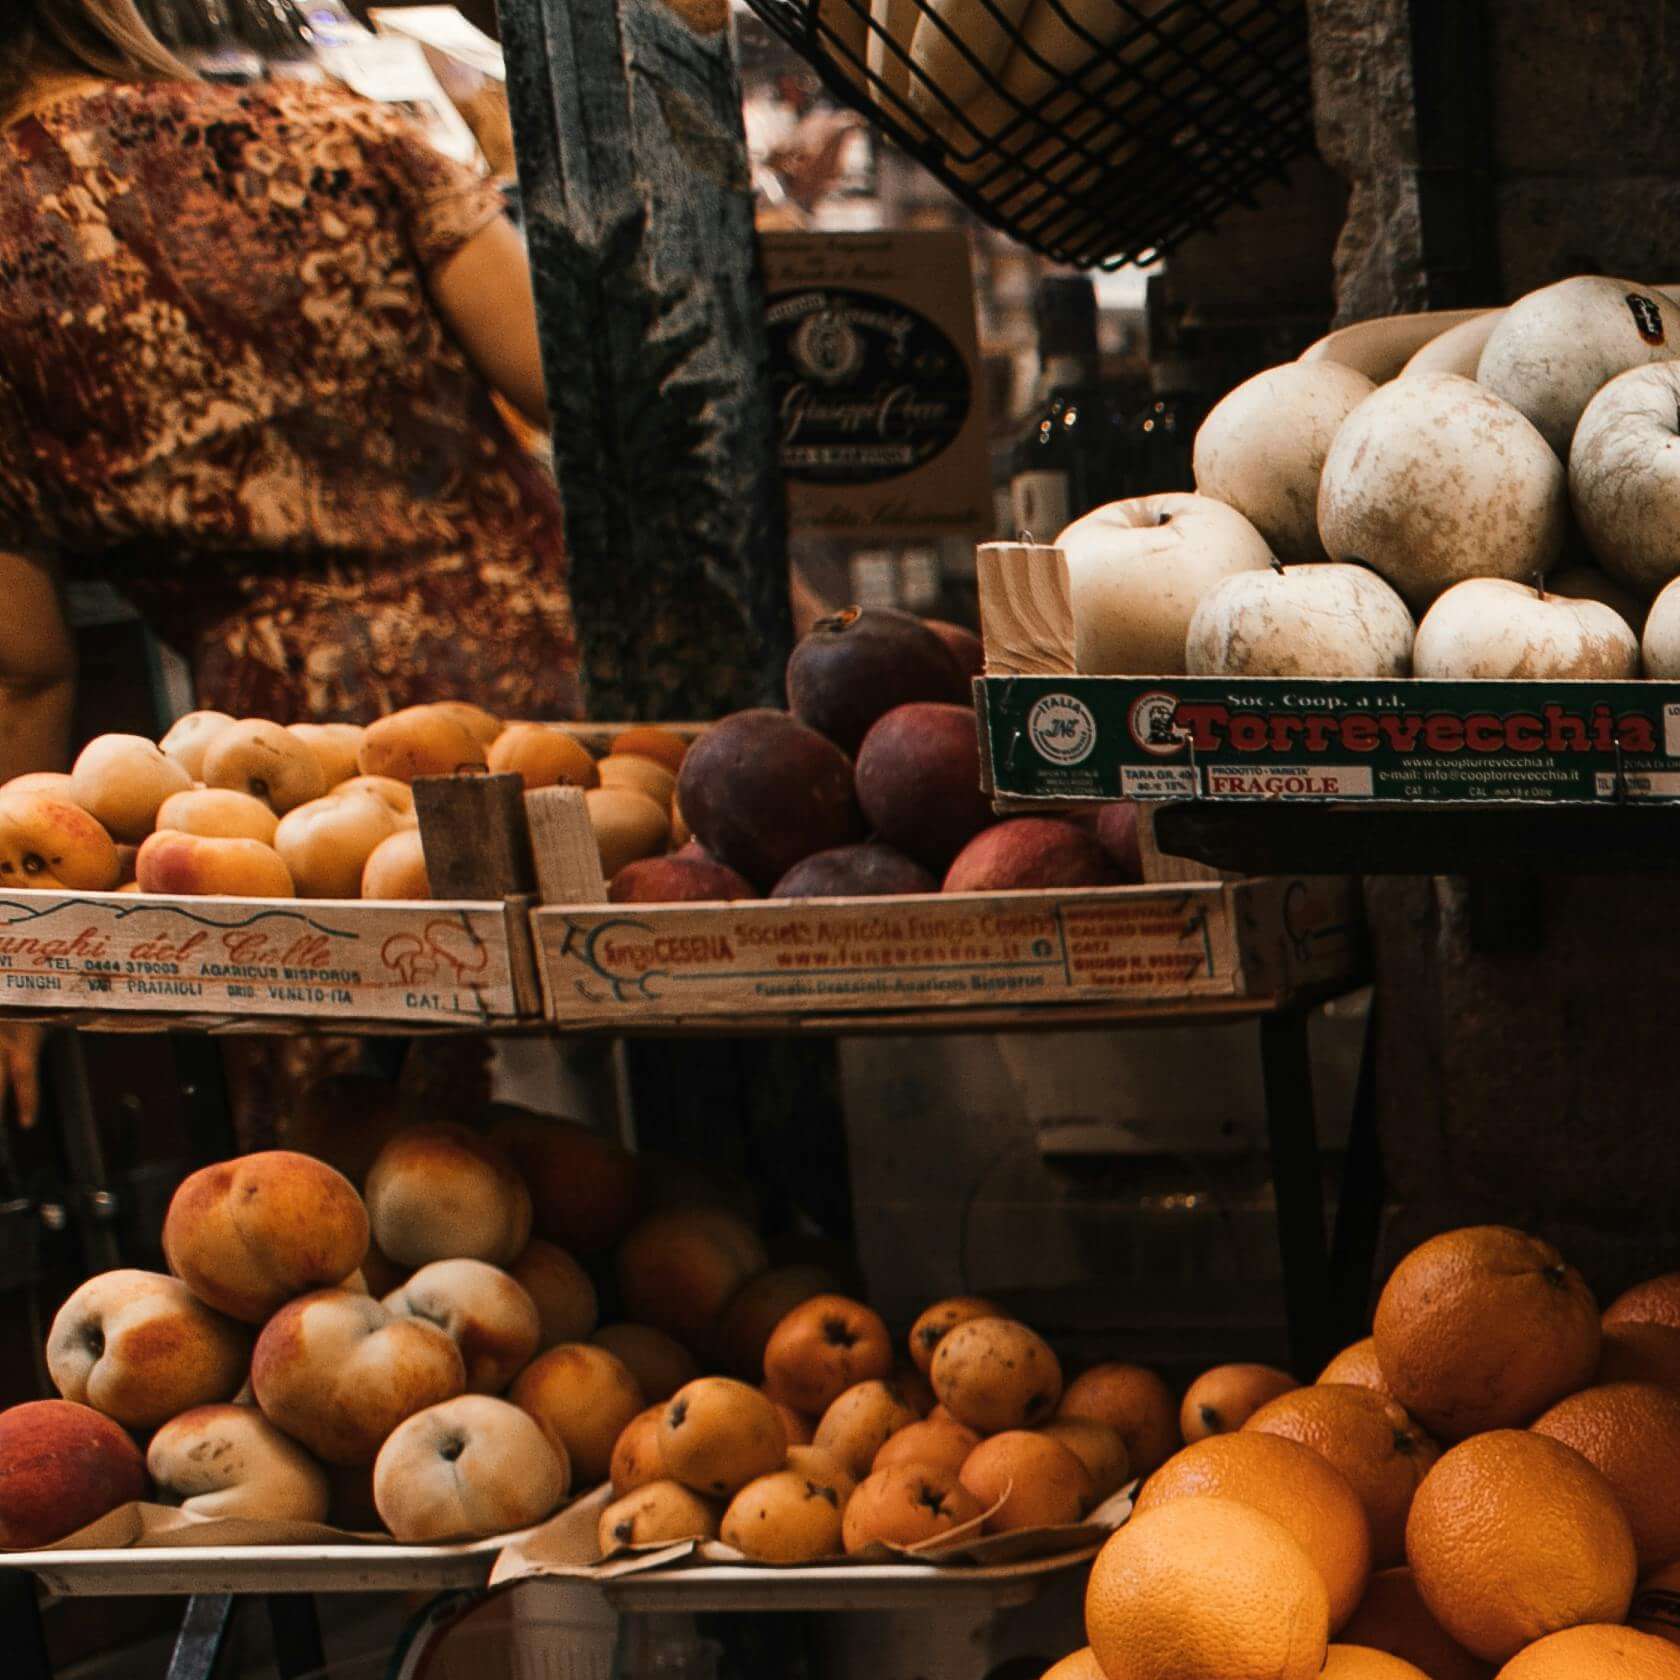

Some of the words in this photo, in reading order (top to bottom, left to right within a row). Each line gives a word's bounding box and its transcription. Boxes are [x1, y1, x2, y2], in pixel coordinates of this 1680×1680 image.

[1282, 694, 1349, 712] Coop.
[1173, 701, 1658, 754] Torrevecchia
[1213, 775, 1339, 794] FRAGOLE
[0, 926, 107, 966] unghi
[6, 974, 61, 990] FUNGHI
